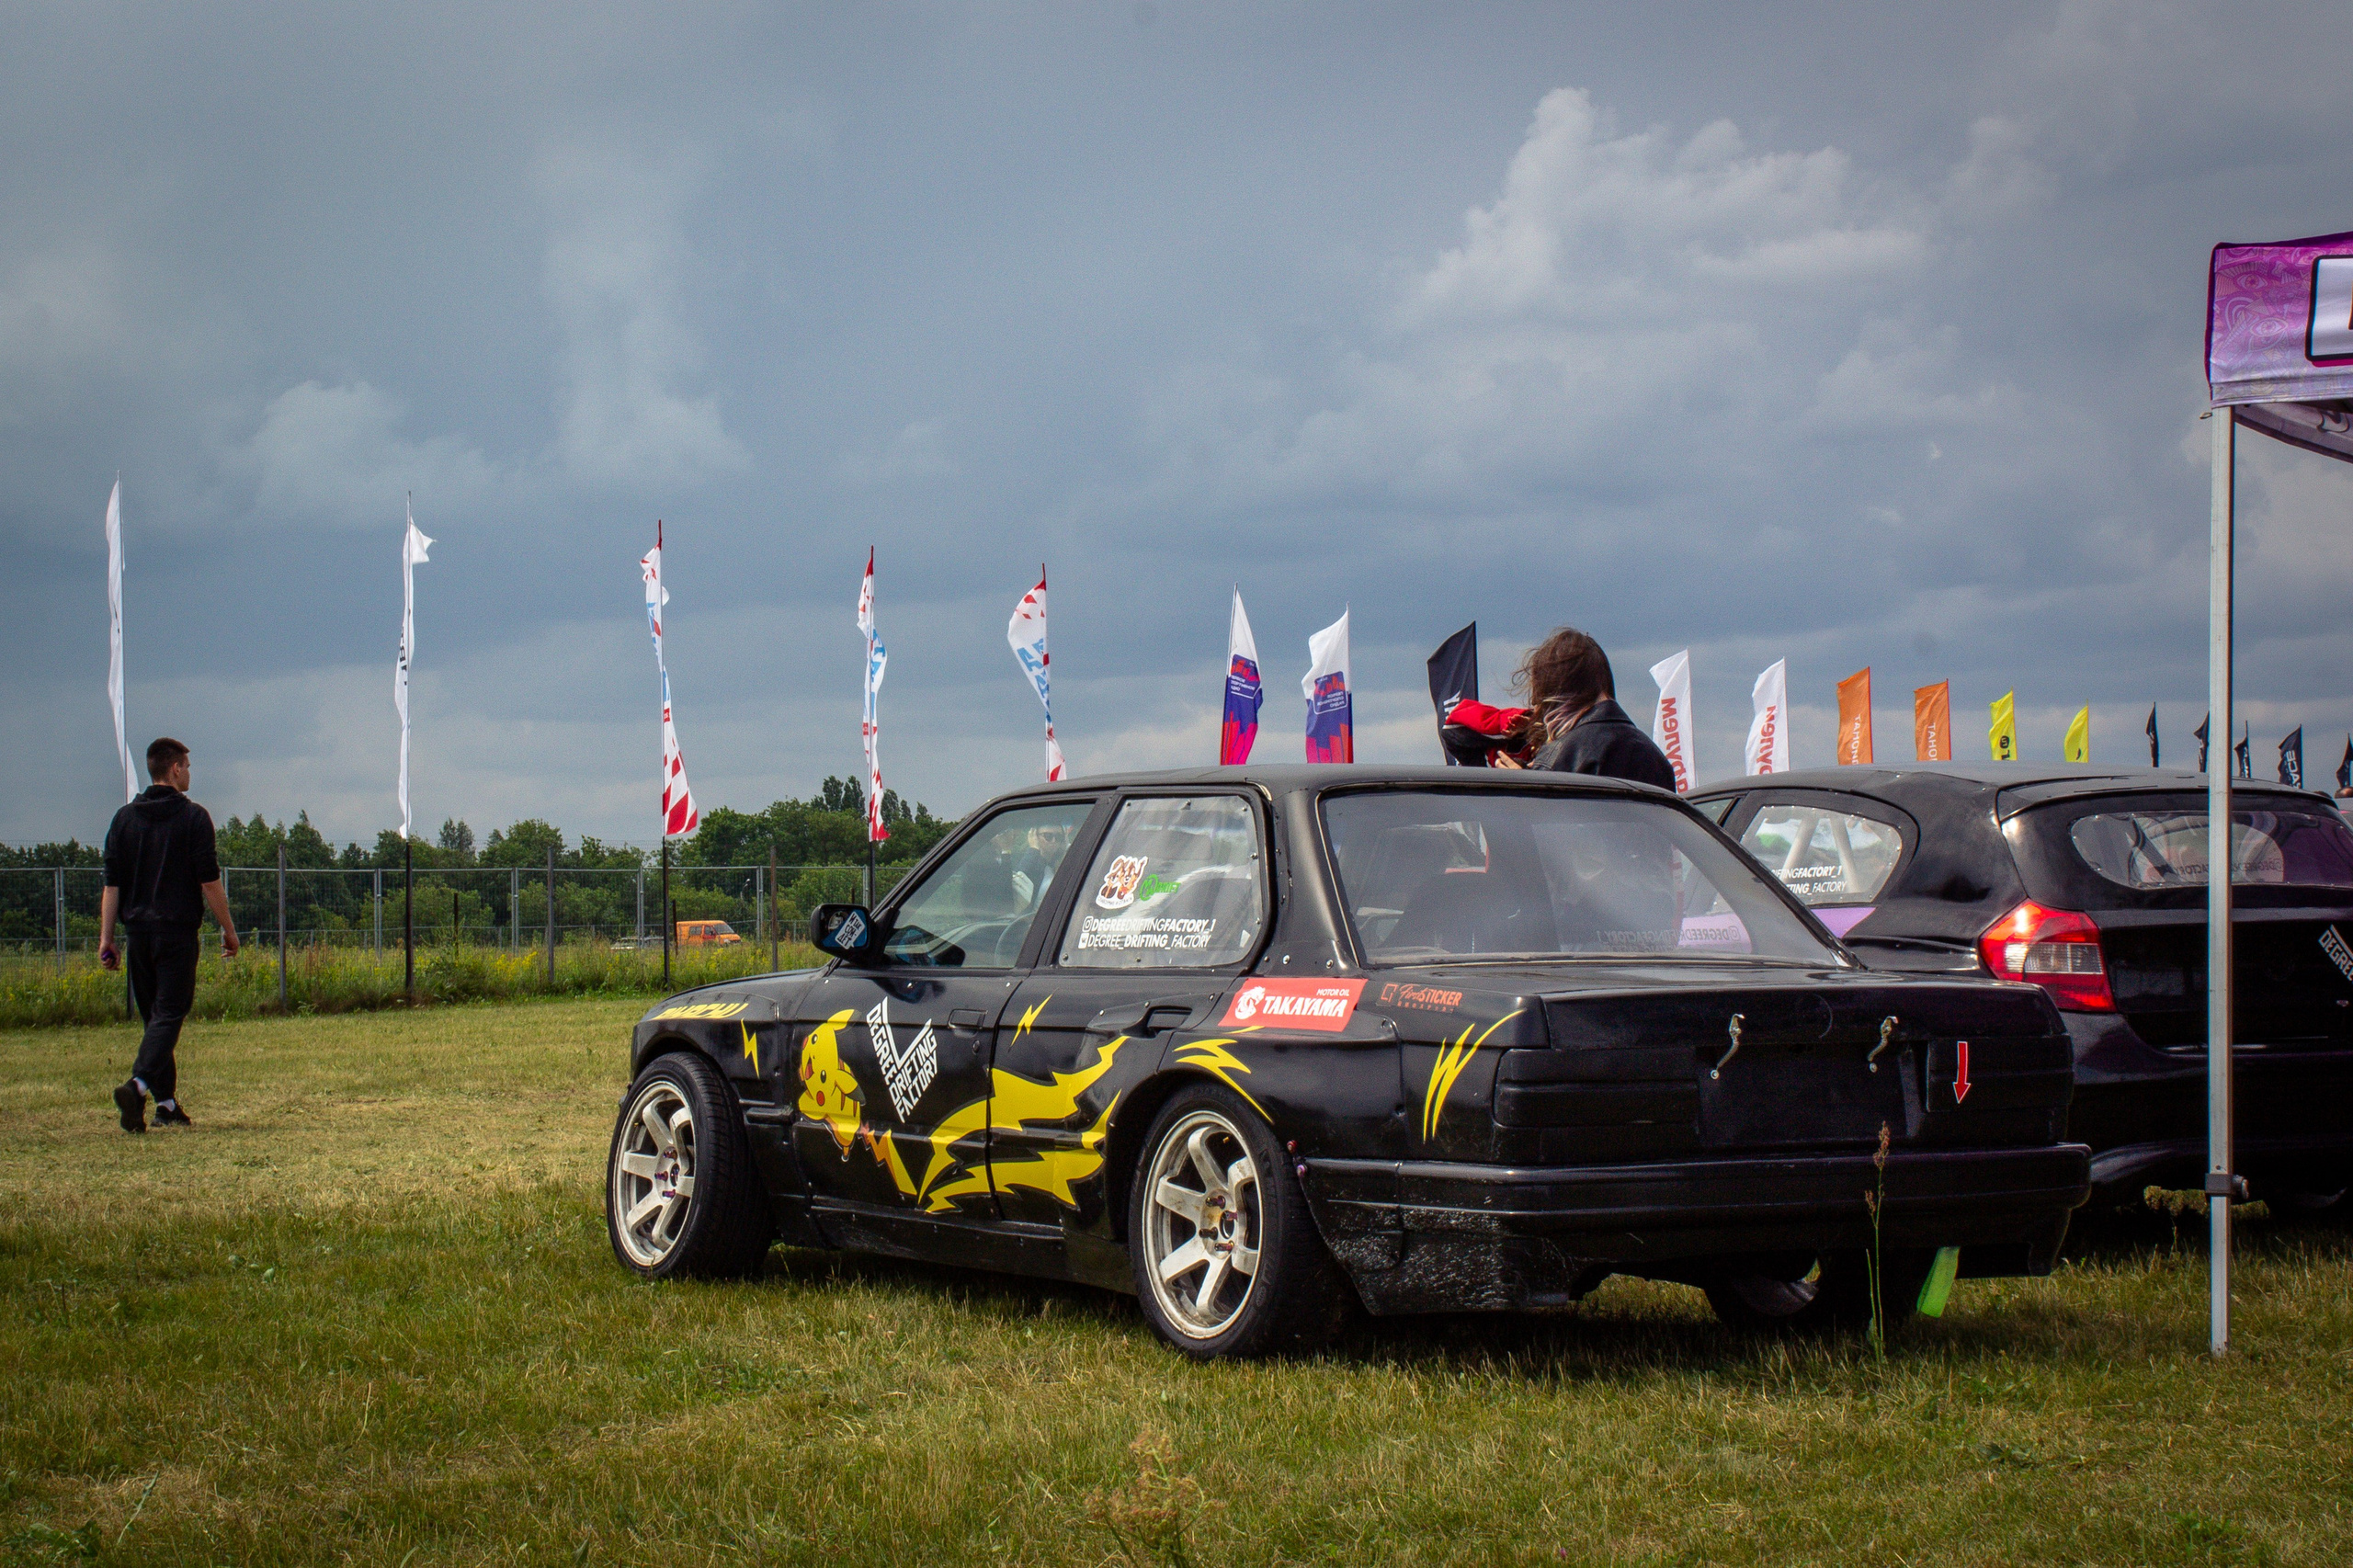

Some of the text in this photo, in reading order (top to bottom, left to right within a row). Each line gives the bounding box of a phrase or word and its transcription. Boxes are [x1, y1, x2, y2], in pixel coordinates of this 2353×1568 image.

[1087, 934, 1211, 949] DEGREE_DRIFTING_FACTORY
[1262, 995, 1348, 1017] TAKAYAMA
[1316, 988, 1350, 996] MOTOR OIL
[866, 1002, 898, 1085] DEGREE
[888, 1028, 938, 1107] DRIFTING
[895, 1049, 938, 1124] FACTORY
